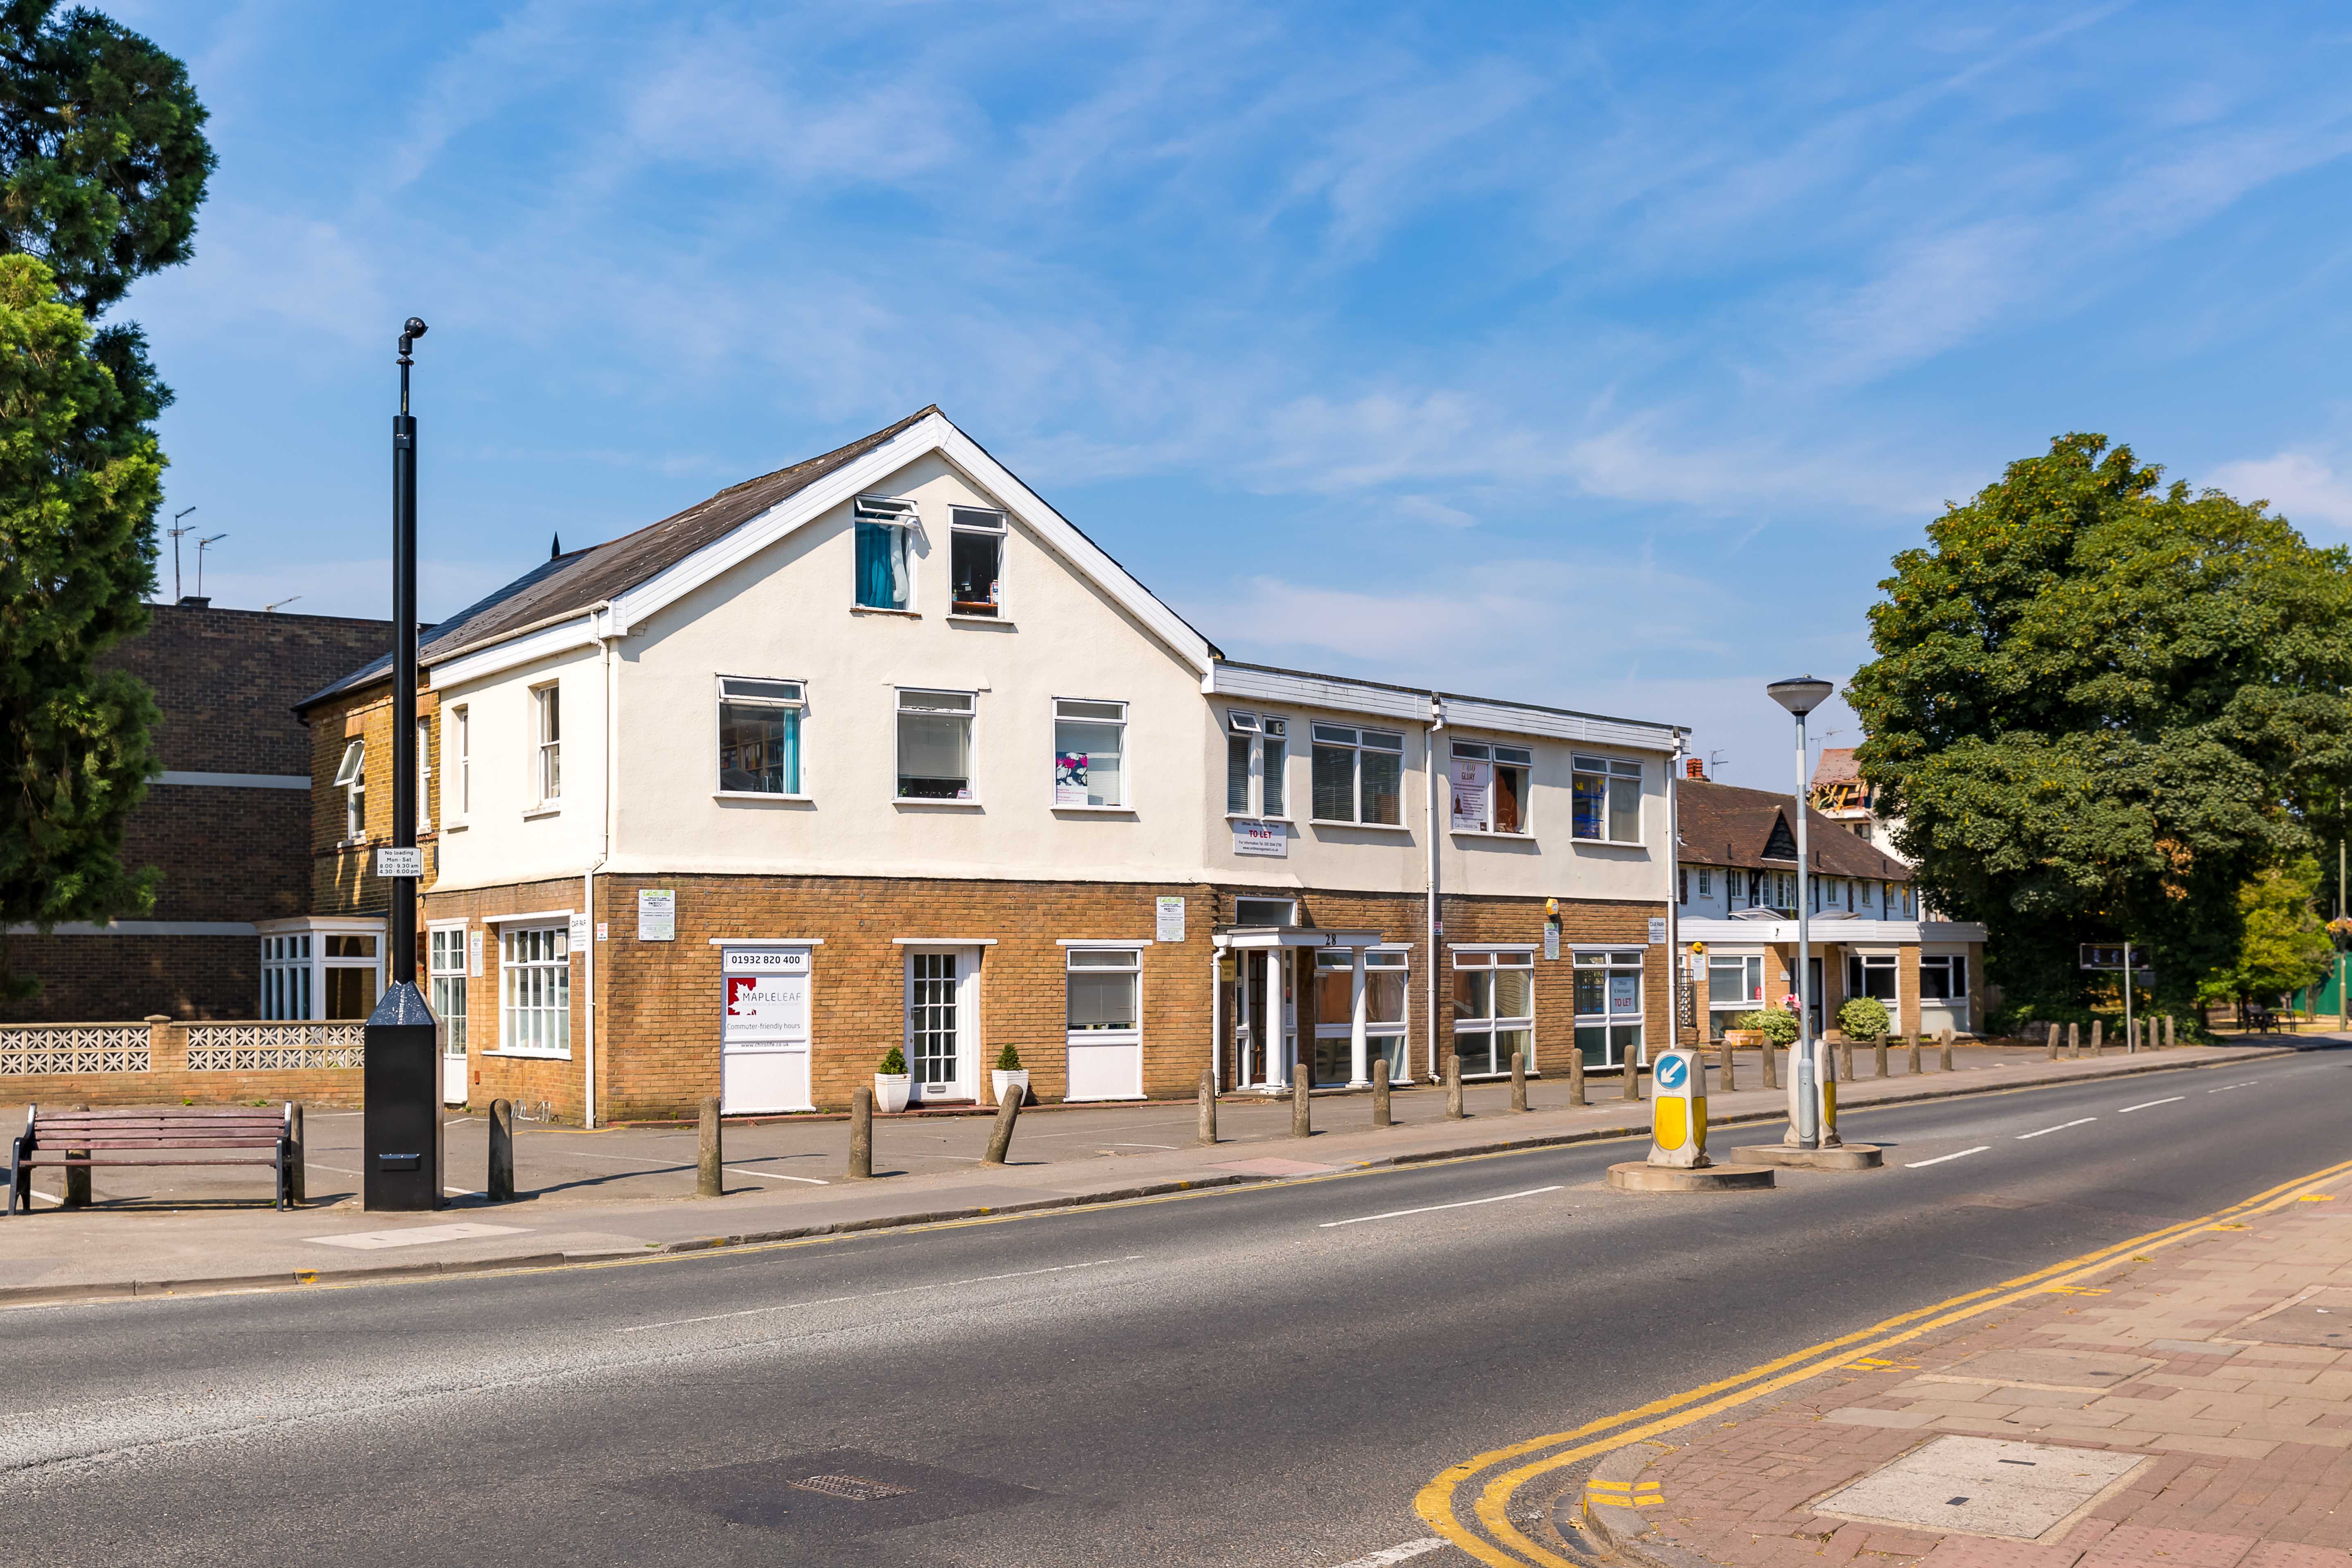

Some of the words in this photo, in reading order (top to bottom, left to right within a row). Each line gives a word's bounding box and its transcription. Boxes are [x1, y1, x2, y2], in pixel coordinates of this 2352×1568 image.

[1461, 772, 1475, 781] GLUAY
[1325, 933, 1336, 945] 28
[1614, 998, 1622, 1007] TO
[1623, 998, 1631, 1006] LET
